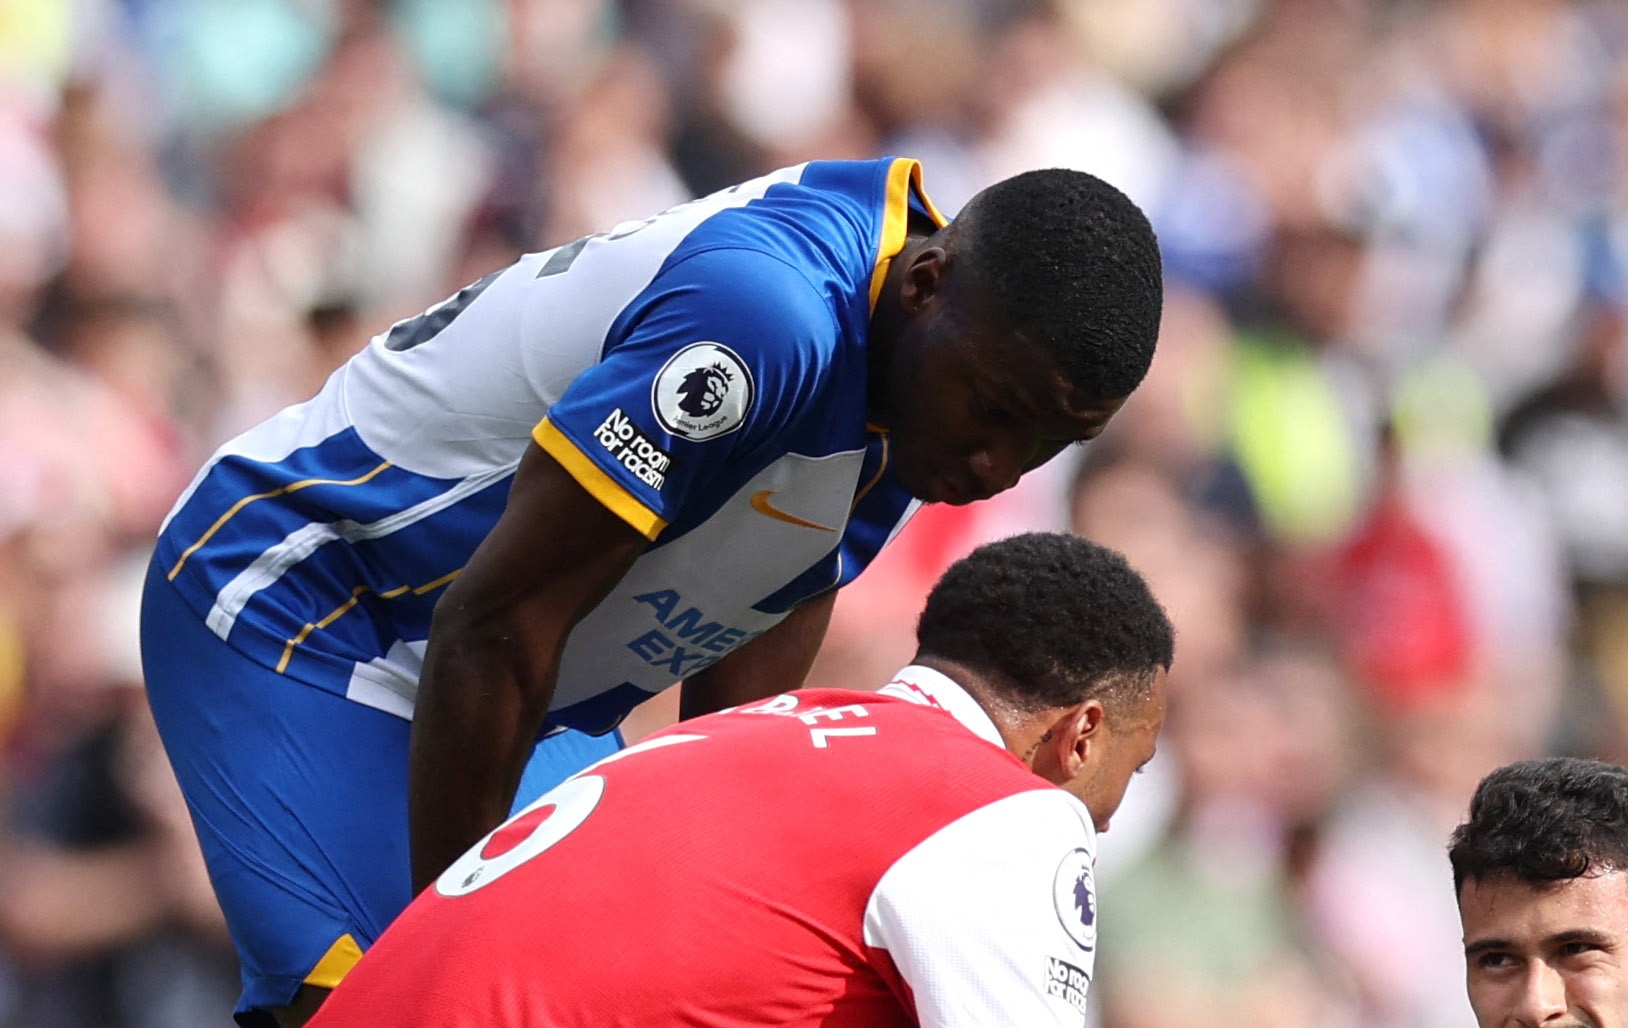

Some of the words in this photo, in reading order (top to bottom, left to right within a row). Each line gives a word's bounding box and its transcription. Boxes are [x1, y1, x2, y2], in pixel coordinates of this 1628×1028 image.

[605, 408, 634, 440] No
[630, 435, 671, 473] room
[616, 447, 665, 491] racism
[1047, 956, 1068, 983] No
[1067, 968, 1090, 997] roo
